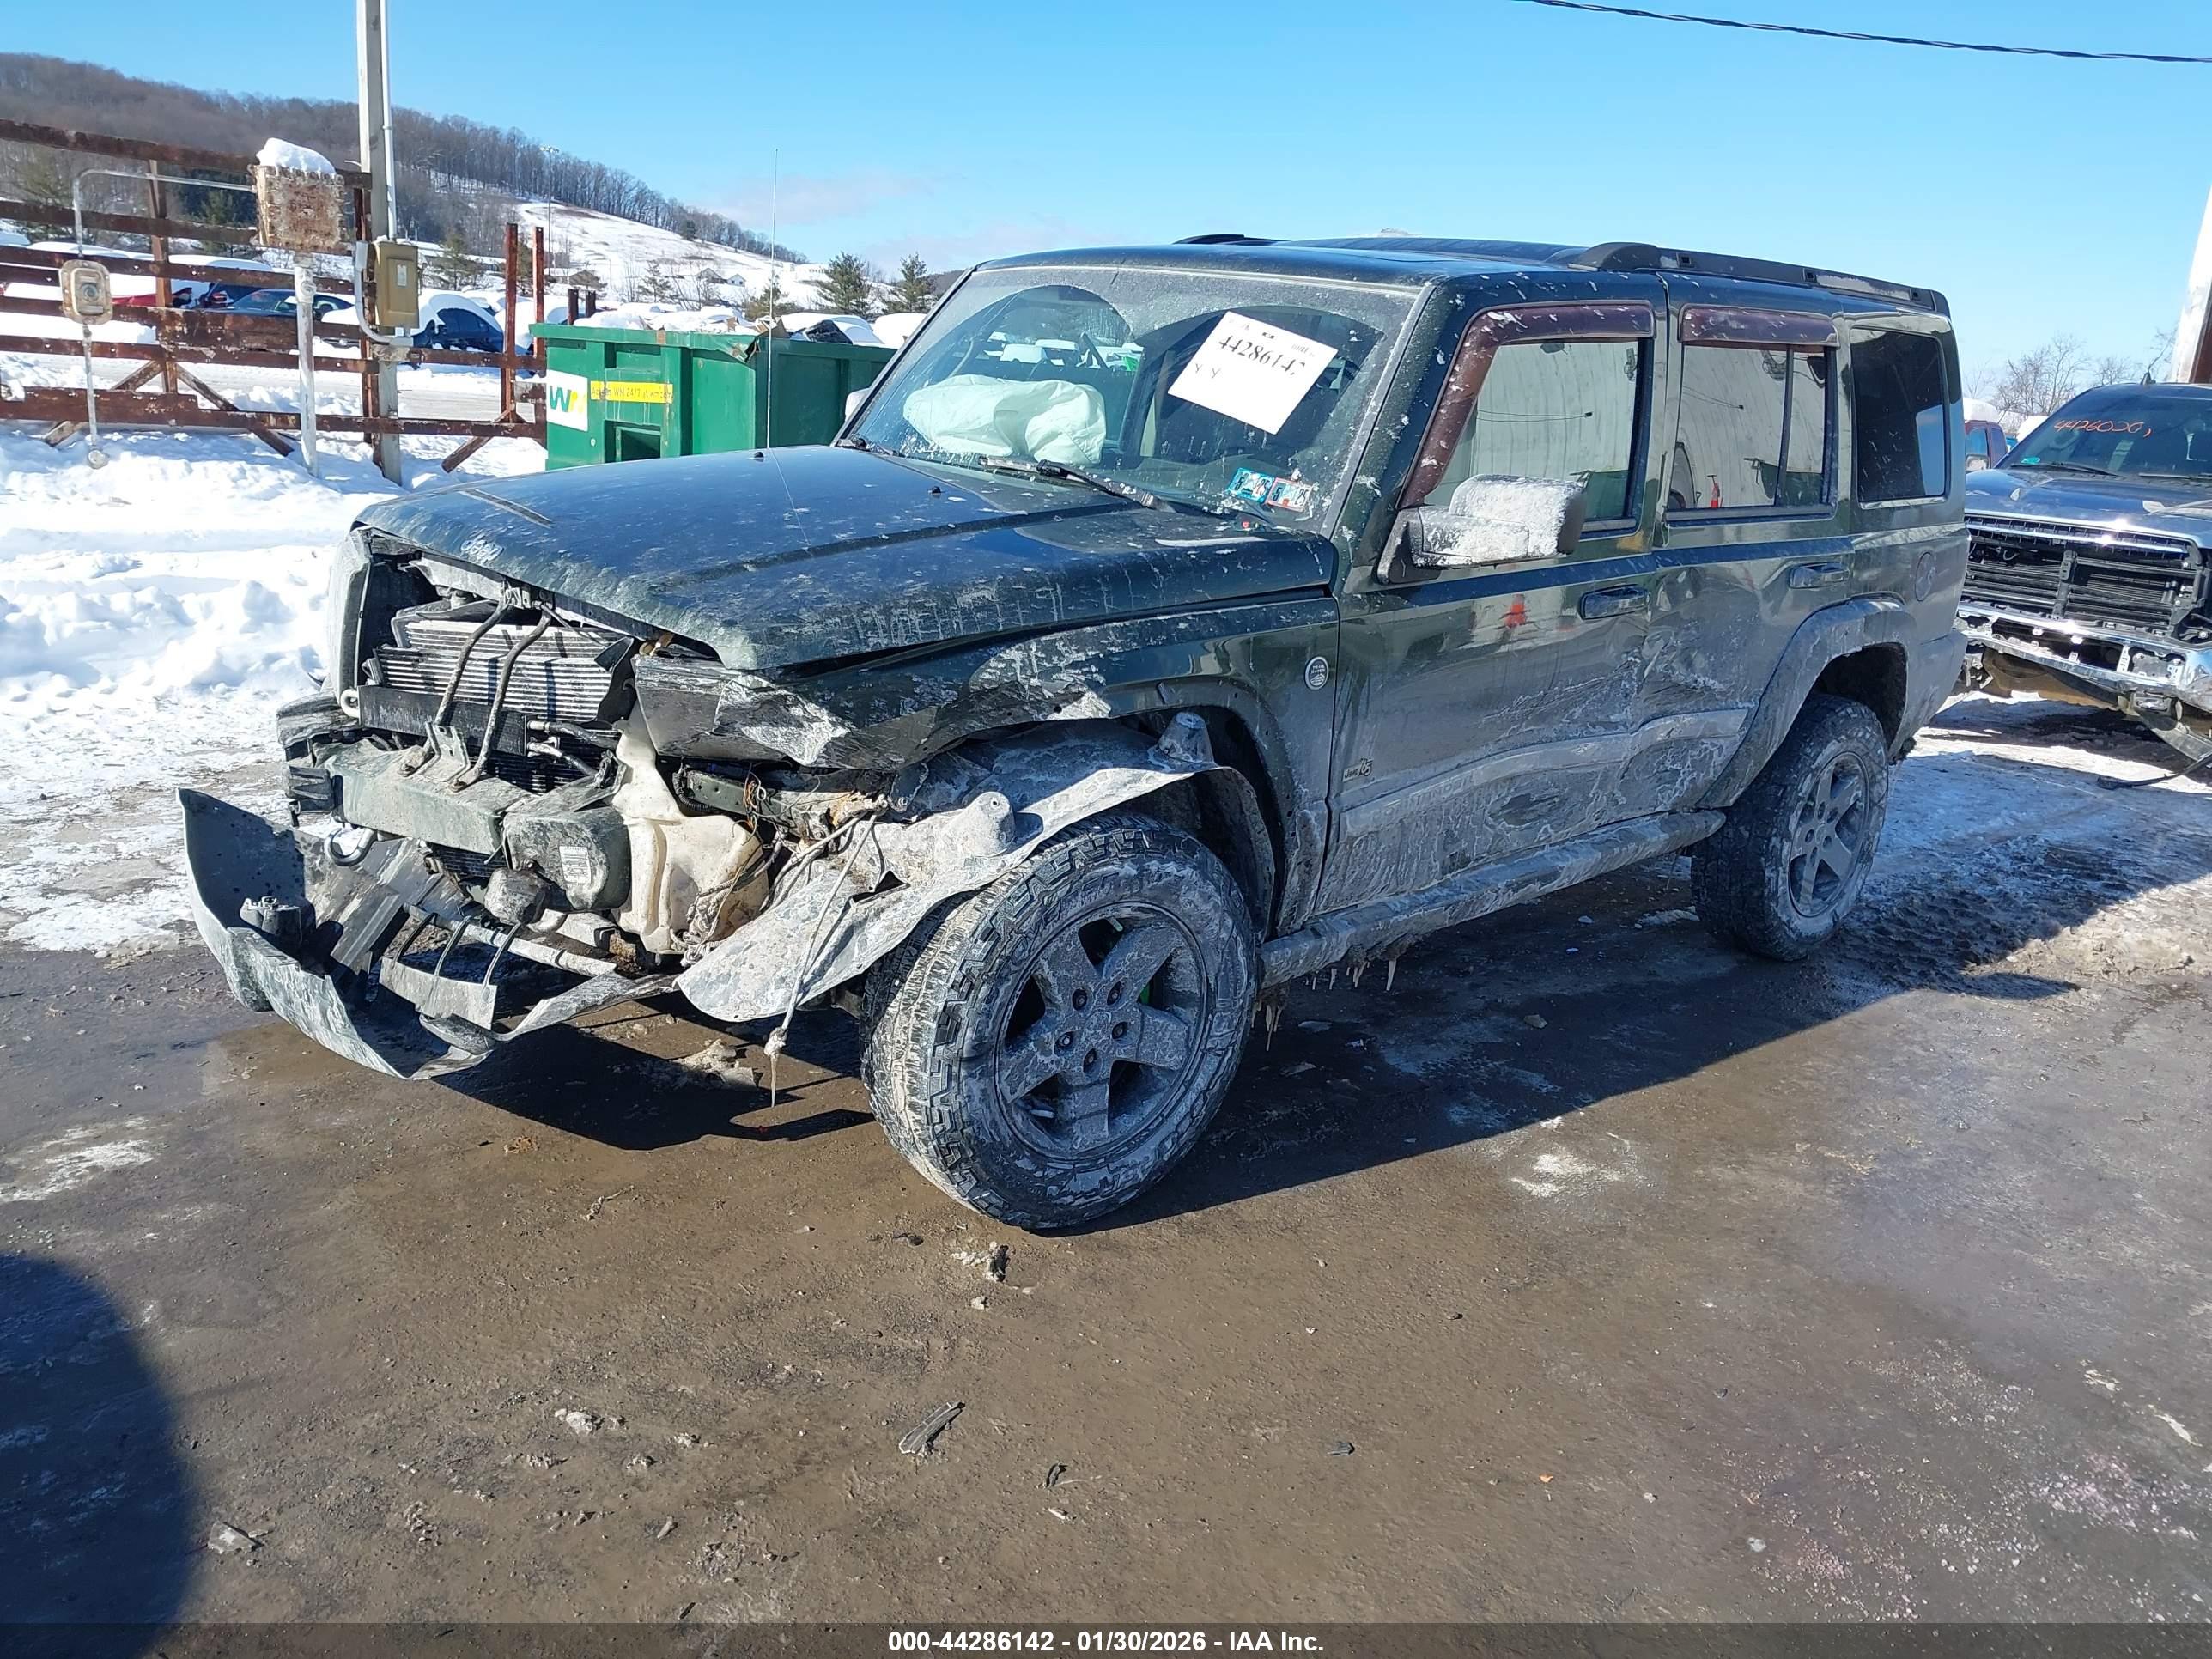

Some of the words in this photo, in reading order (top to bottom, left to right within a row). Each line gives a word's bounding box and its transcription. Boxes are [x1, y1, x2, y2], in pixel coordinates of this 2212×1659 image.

[626, 387, 641, 398] 24/7
[1273, 486, 1283, 501] 5
[460, 533, 505, 564] Jeep
